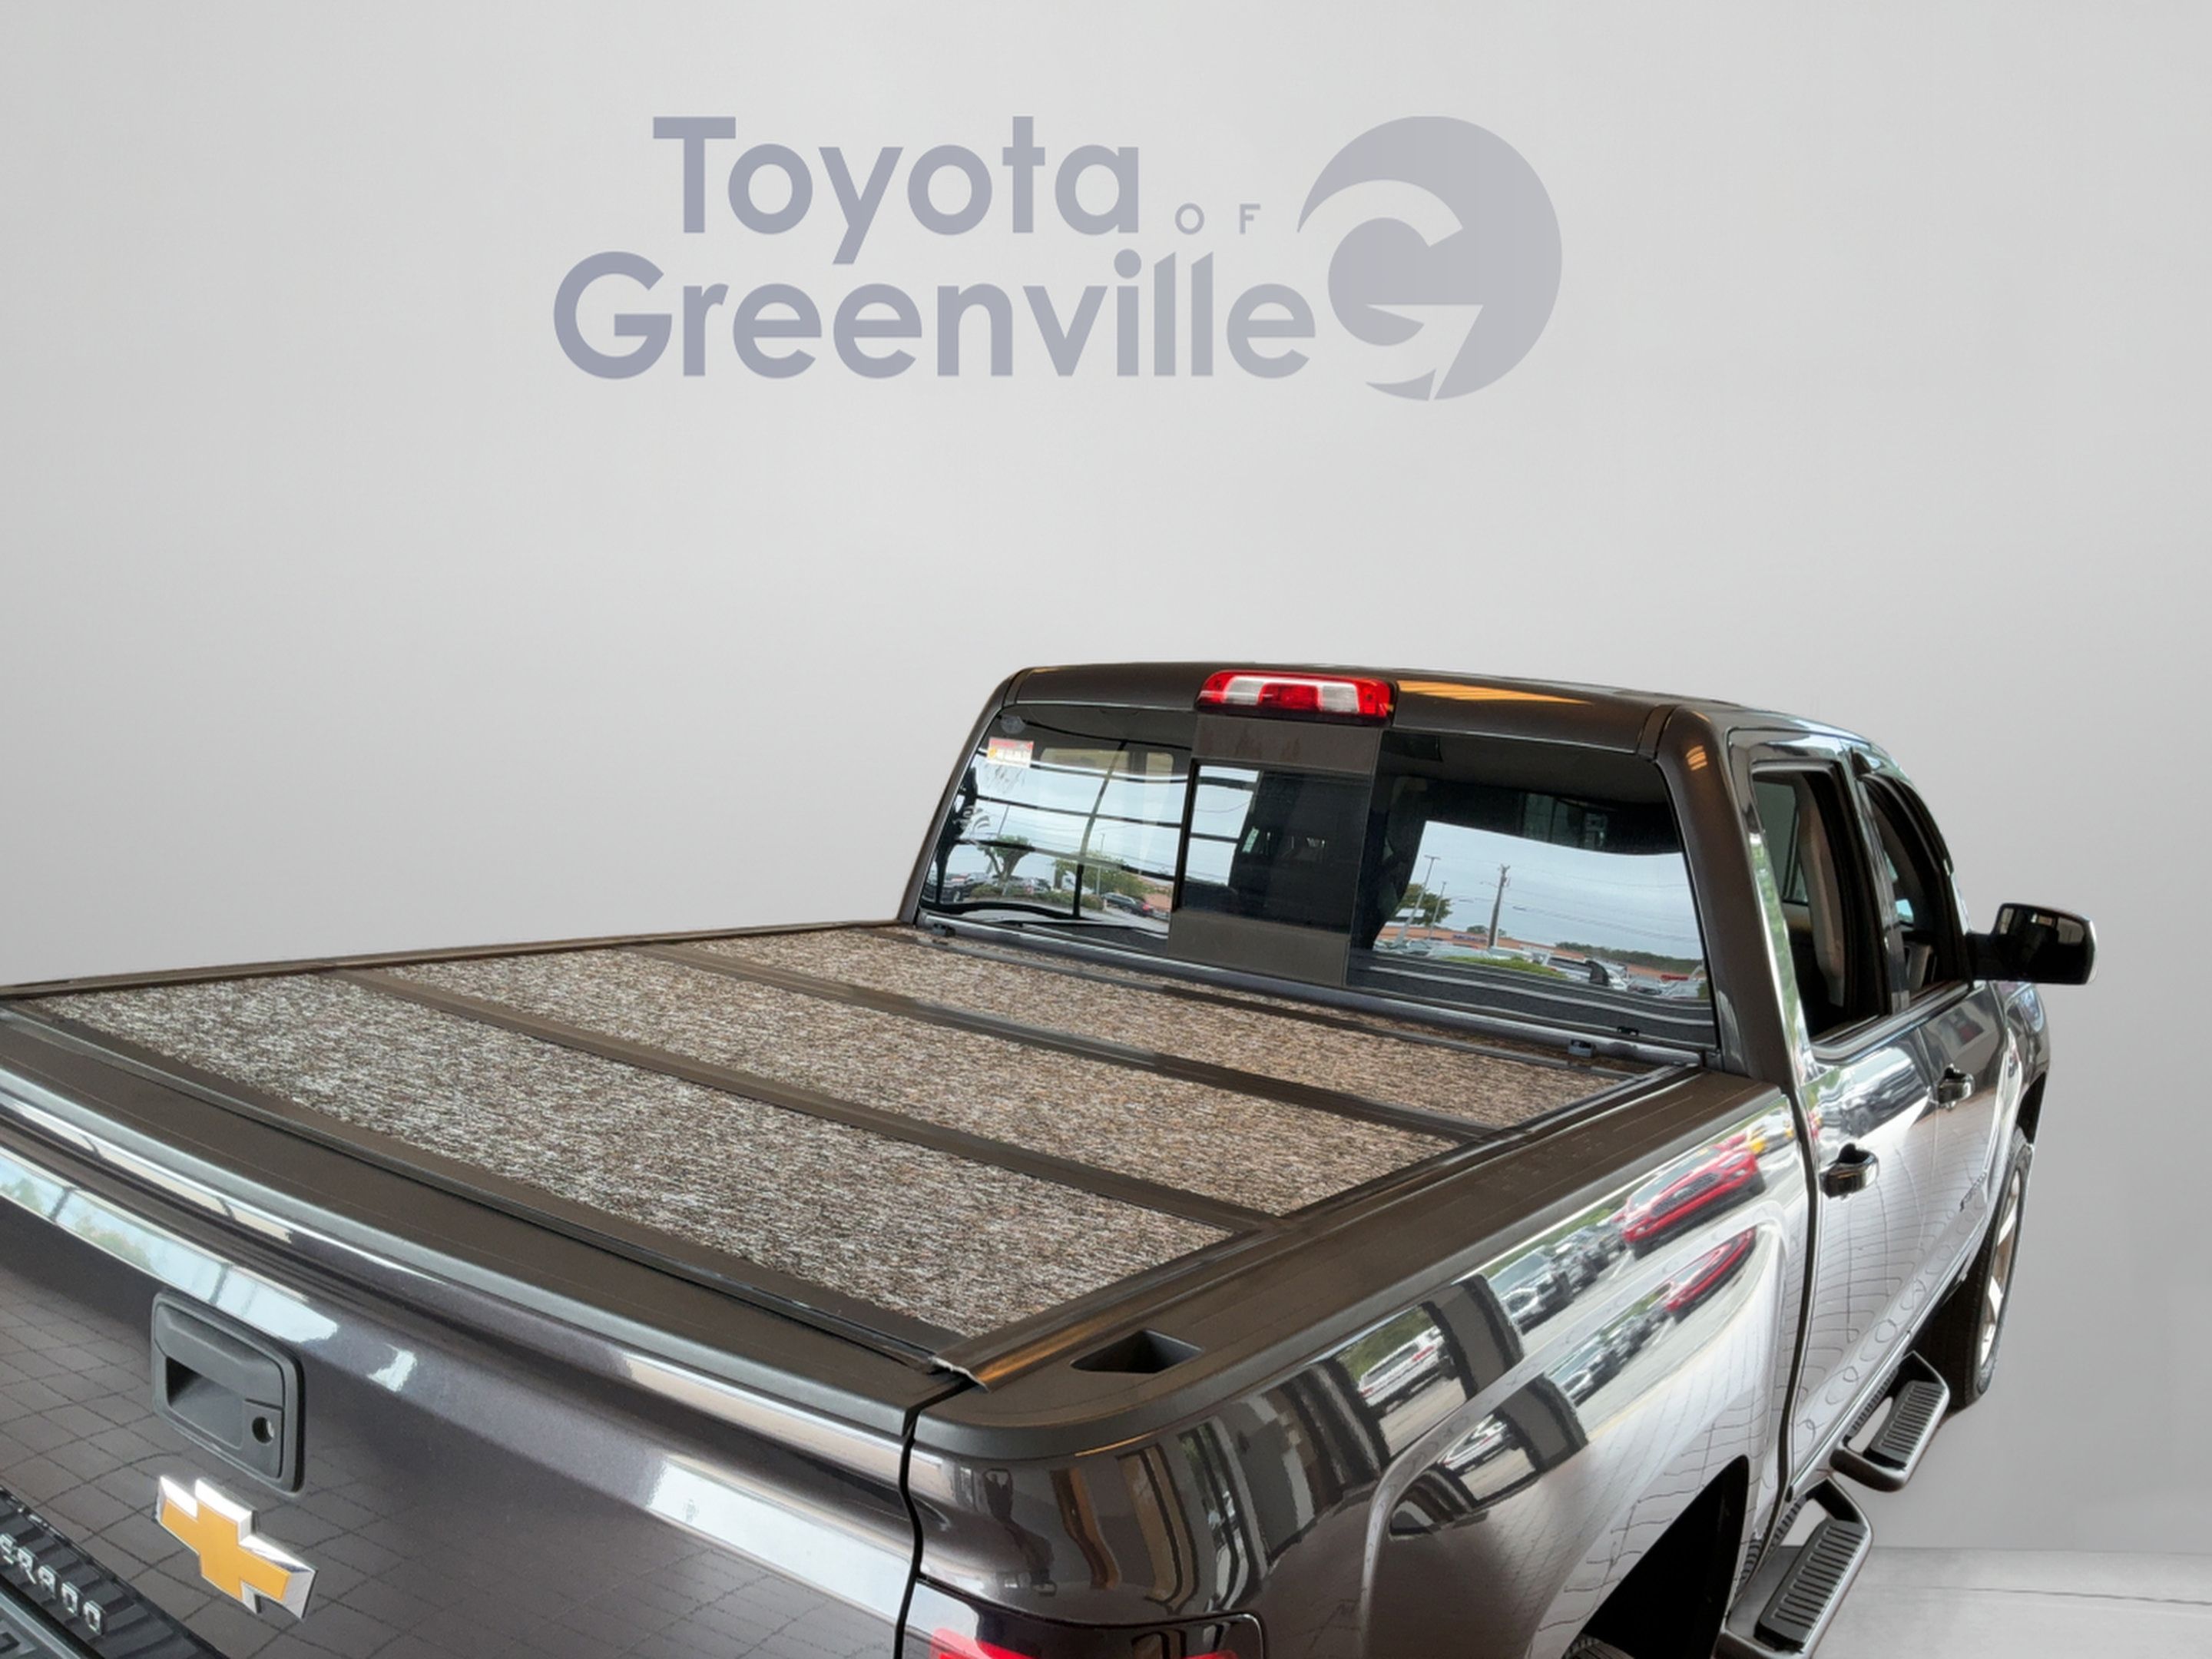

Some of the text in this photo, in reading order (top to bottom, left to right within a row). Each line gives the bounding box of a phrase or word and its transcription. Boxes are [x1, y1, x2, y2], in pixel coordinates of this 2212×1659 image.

[653, 116, 1261, 266] Toyota OF
[553, 248, 1316, 380] Greenville
